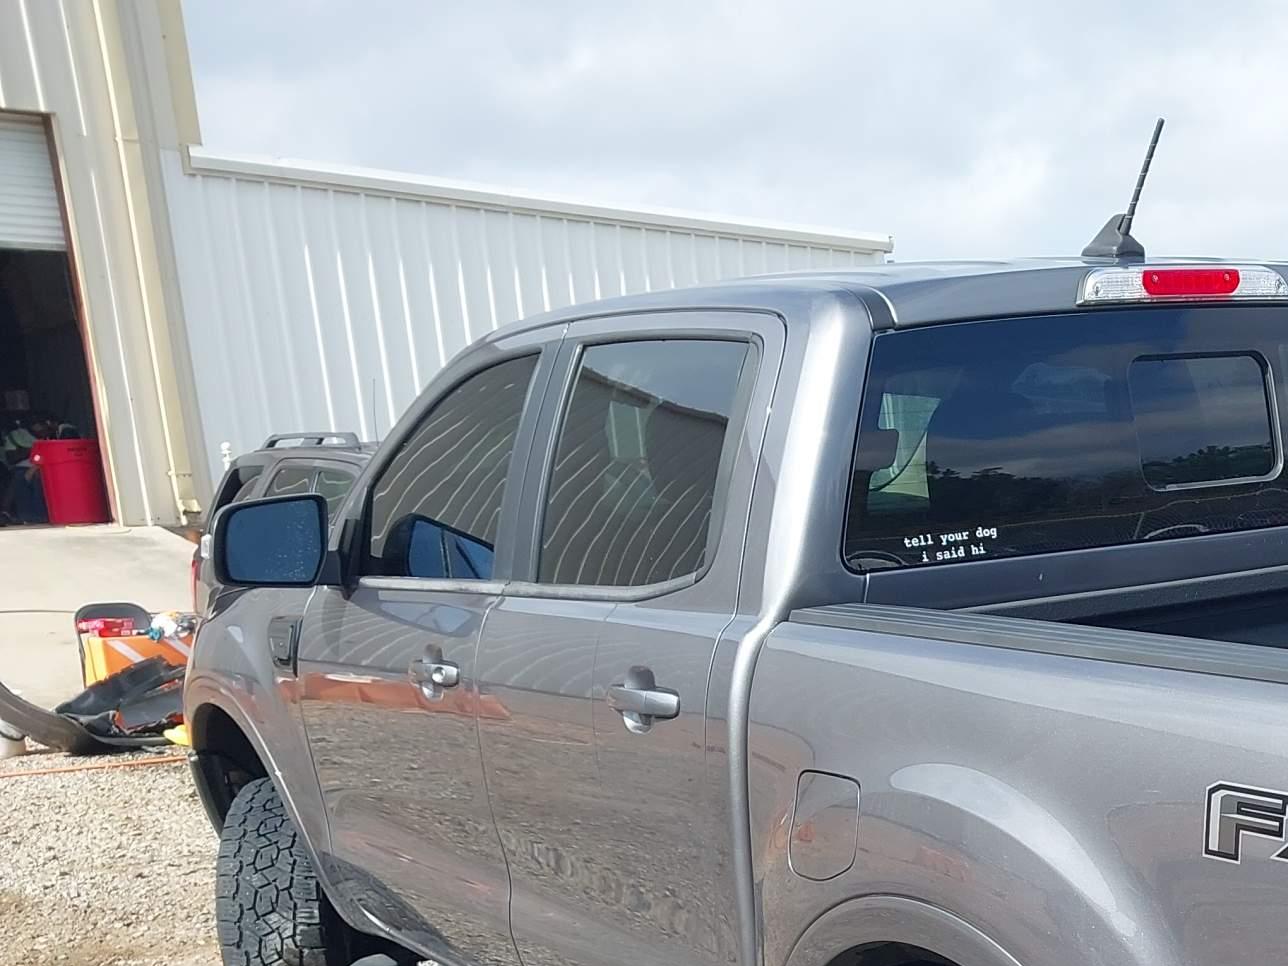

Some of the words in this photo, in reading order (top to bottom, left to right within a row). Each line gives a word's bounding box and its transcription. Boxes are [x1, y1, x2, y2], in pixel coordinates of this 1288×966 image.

[904, 534, 934, 547] tell
[940, 531, 969, 546] your
[975, 527, 997, 539] dog
[922, 551, 929, 562] i
[936, 546, 965, 560] said
[971, 543, 986, 555] hi
